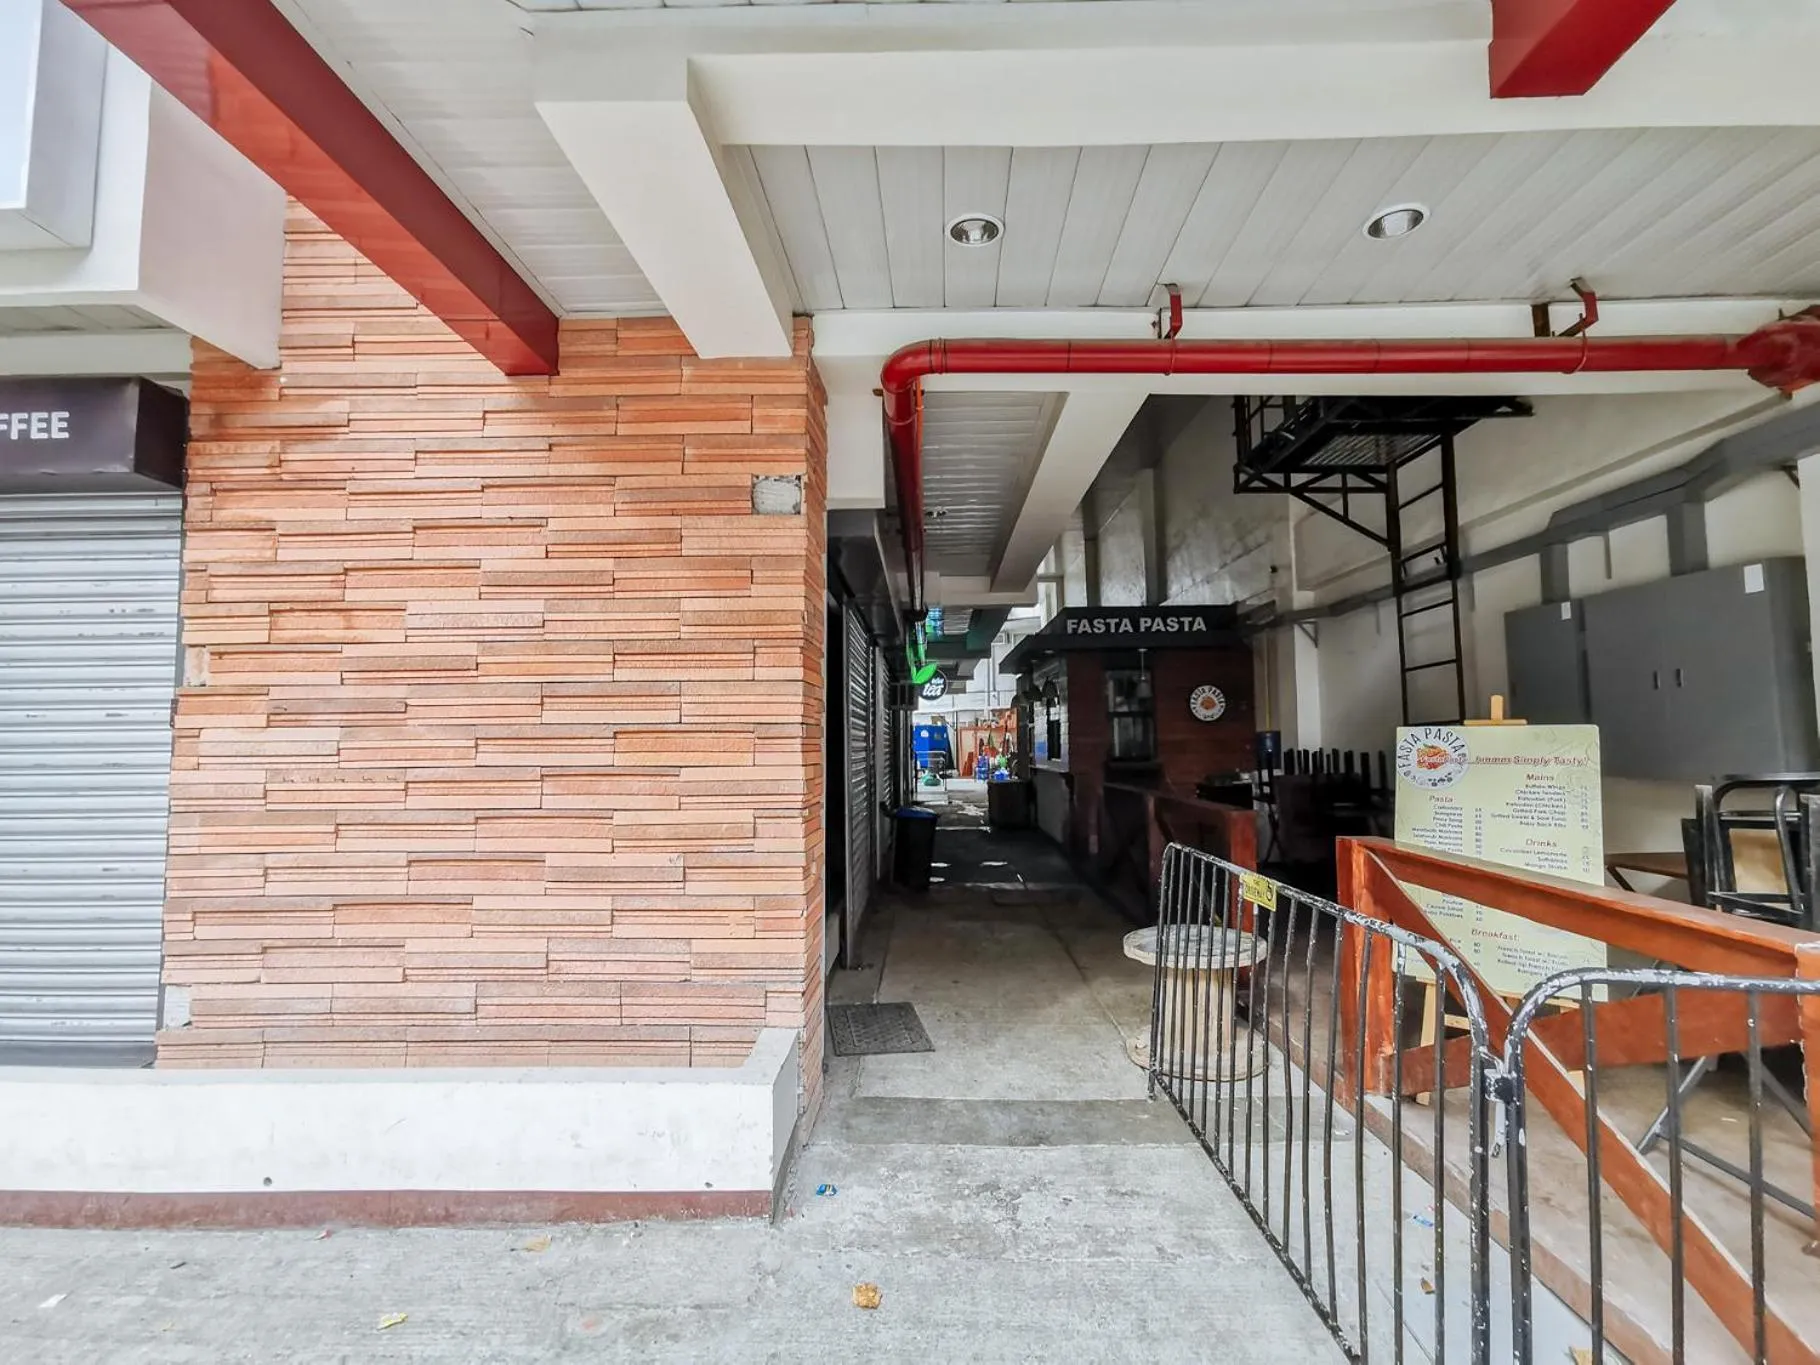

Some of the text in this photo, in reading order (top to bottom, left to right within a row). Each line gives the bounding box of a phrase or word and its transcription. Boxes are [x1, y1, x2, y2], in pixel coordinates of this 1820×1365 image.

[1067, 616, 1207, 634] FASTA PASTA
[1397, 727, 1466, 769] FASTA PASTA
[1513, 755, 1551, 768] Simply
[1526, 773, 1555, 781] Mains
[1429, 795, 1454, 803] Pasta
[1525, 838, 1557, 847] Drinks
